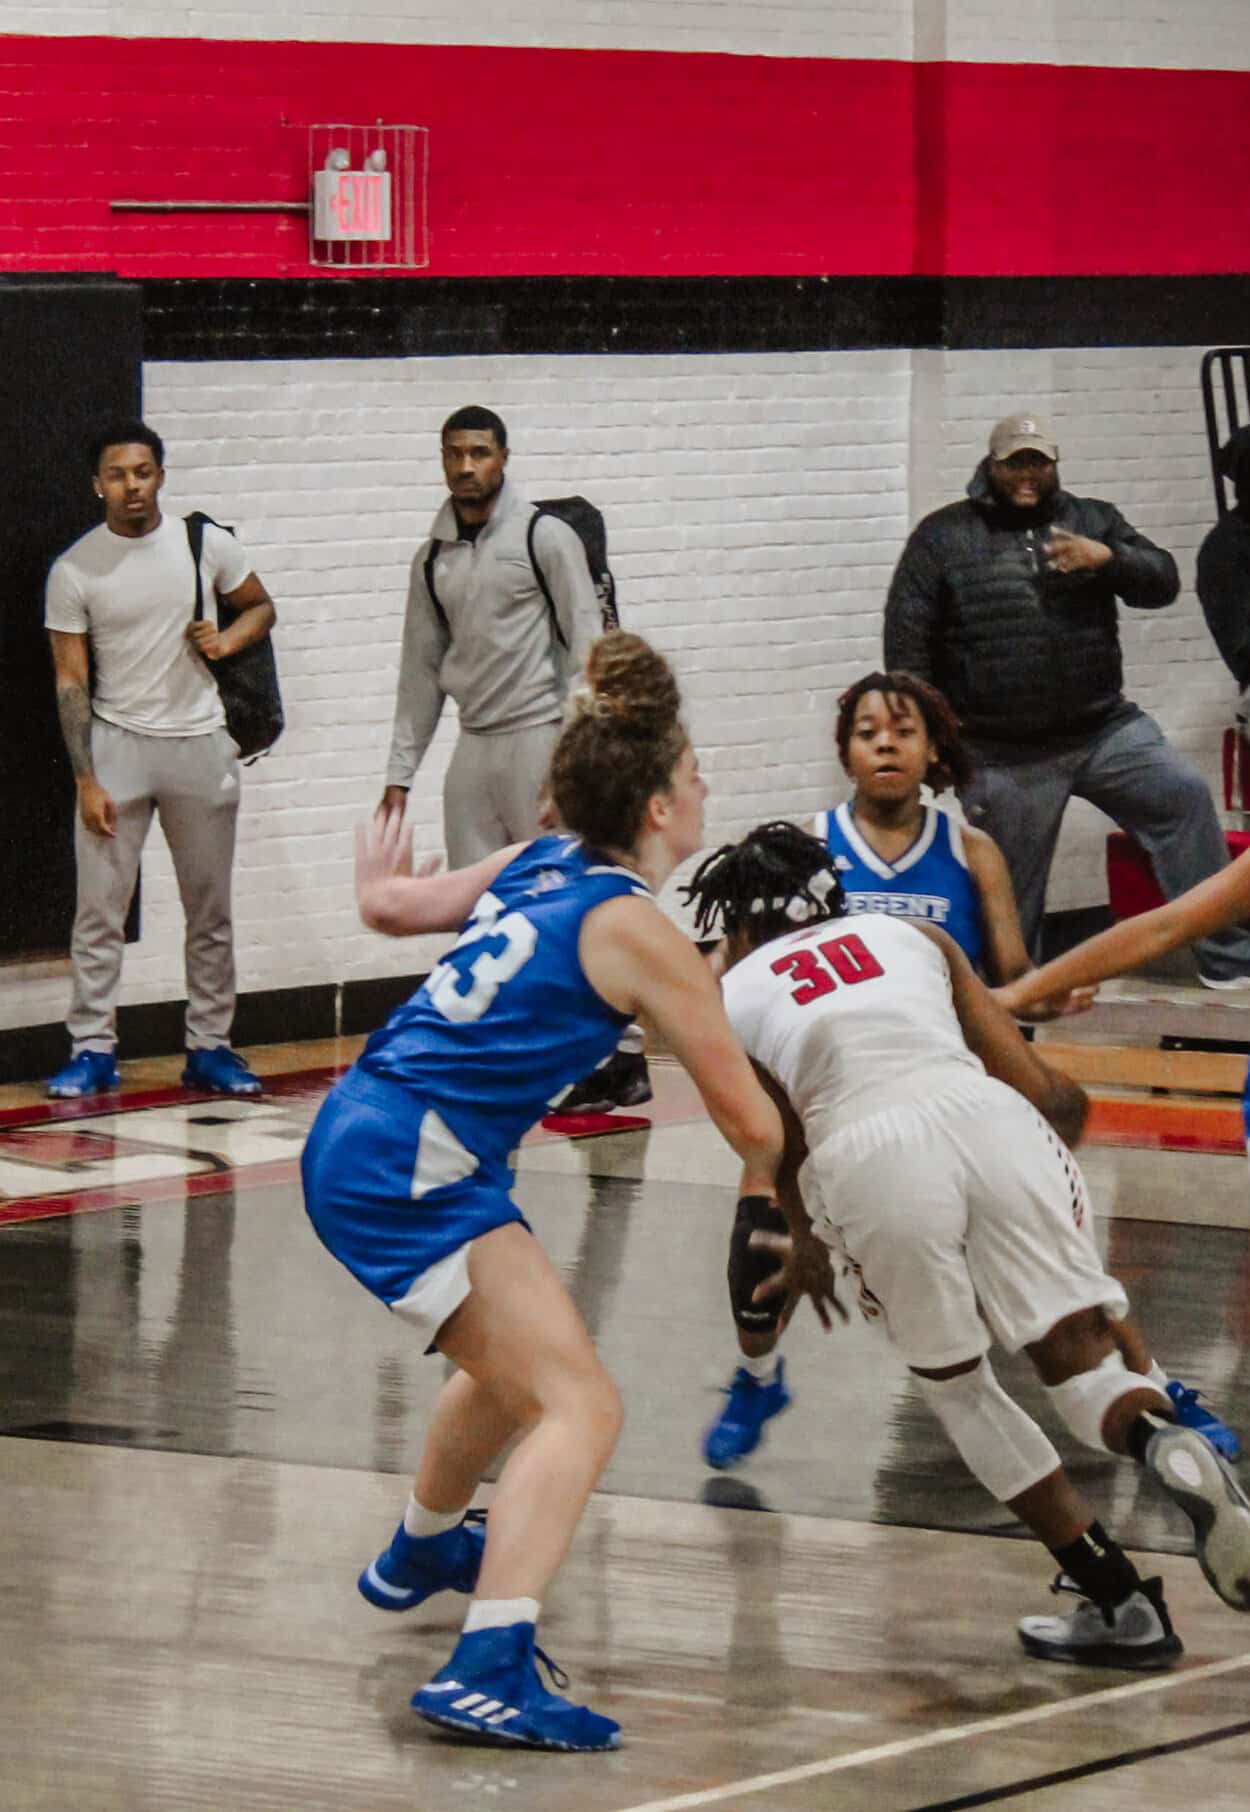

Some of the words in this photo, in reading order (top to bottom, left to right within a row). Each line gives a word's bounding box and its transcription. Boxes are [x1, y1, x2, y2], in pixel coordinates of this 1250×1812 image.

[338, 176, 383, 232] EXIT
[841, 892, 949, 922] EGENT
[769, 933, 885, 1006] 30
